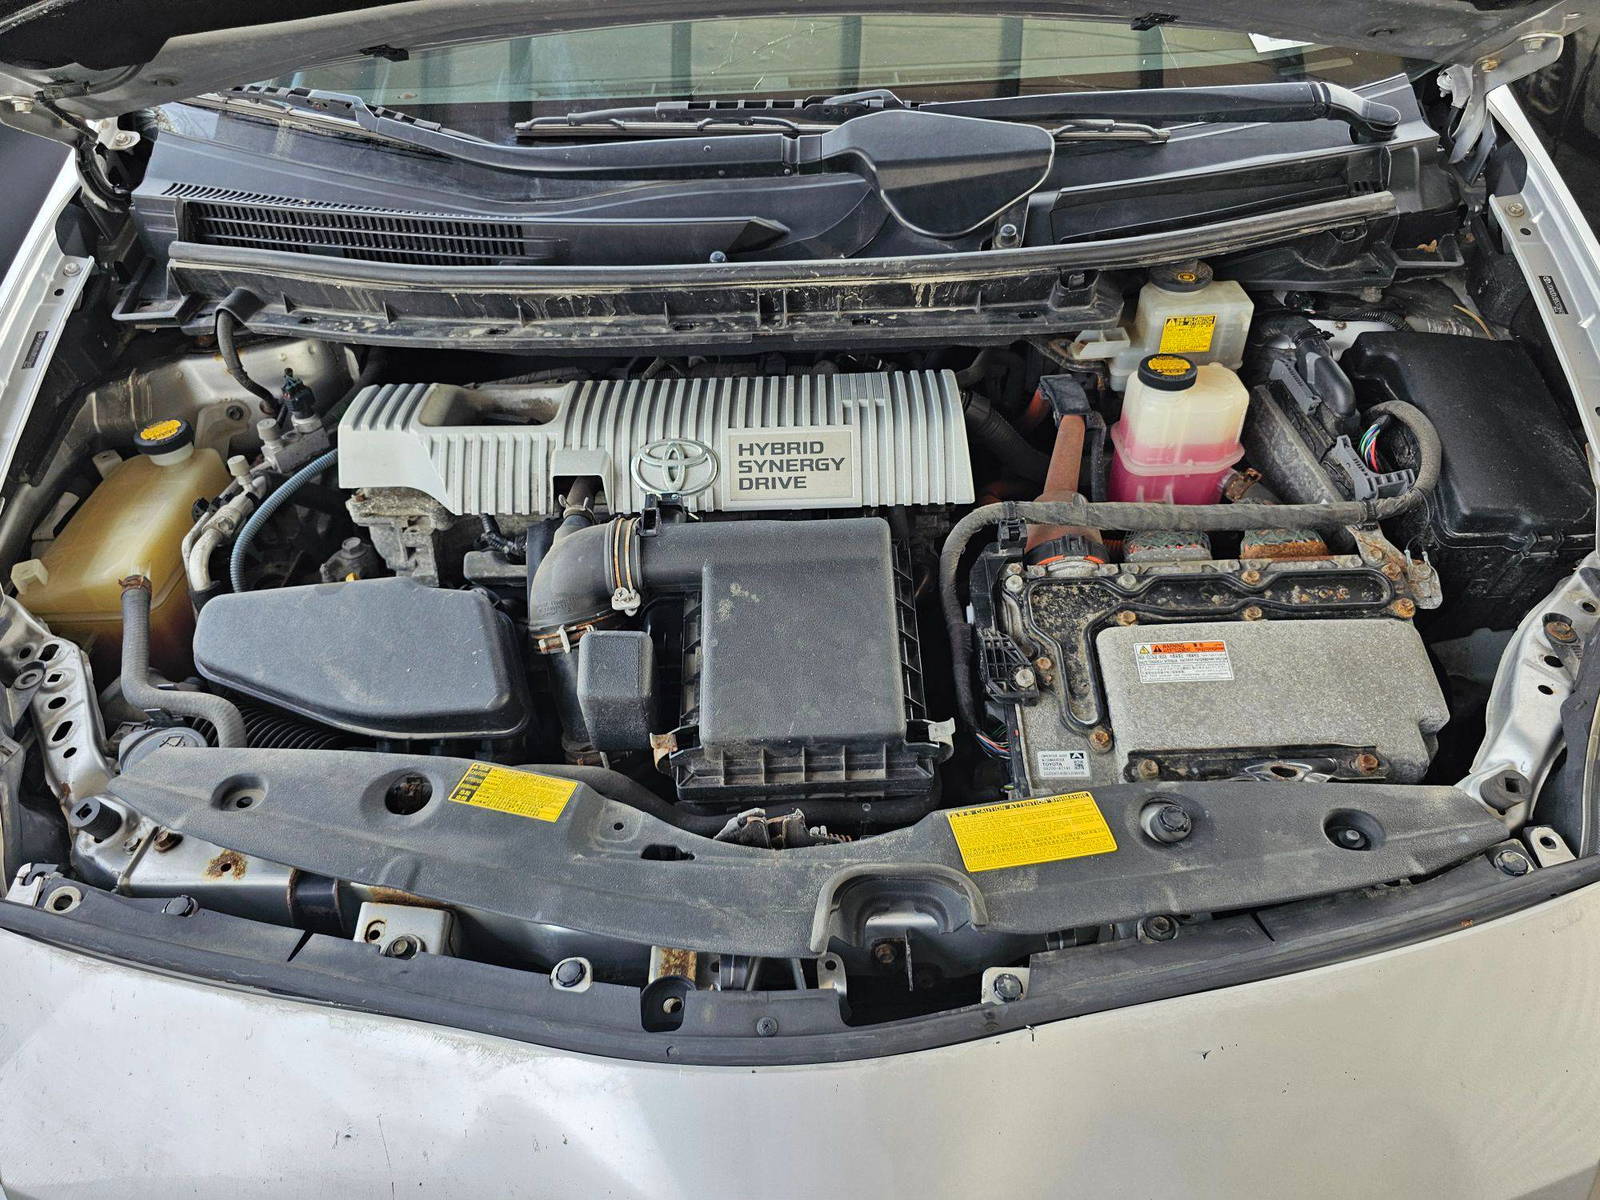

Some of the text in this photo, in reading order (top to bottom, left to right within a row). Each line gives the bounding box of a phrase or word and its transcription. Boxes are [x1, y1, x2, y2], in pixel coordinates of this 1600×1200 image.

[738, 441, 824, 456] HYBRID
[738, 457, 846, 474] SYNERGY
[738, 476, 807, 491] DRIVE
